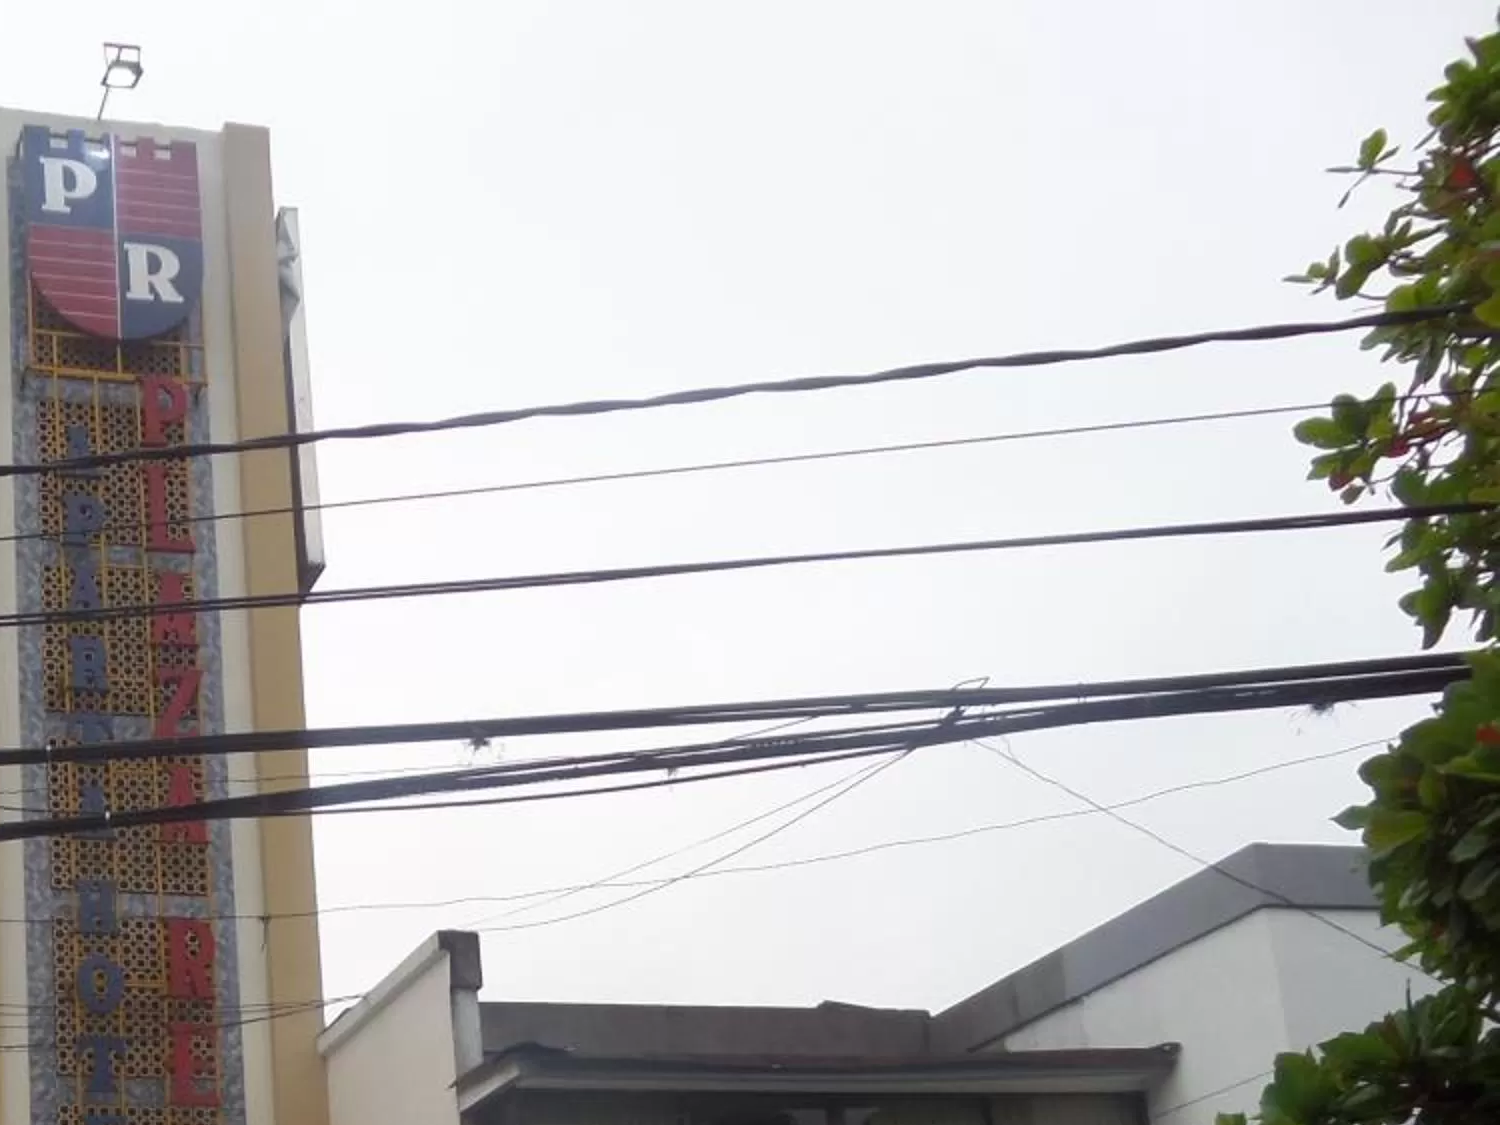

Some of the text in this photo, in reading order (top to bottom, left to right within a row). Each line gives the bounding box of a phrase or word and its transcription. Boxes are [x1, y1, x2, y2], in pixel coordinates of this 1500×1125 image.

[39, 155, 98, 215] P
[123, 241, 186, 304] R
[141, 375, 208, 843] PLAZA
